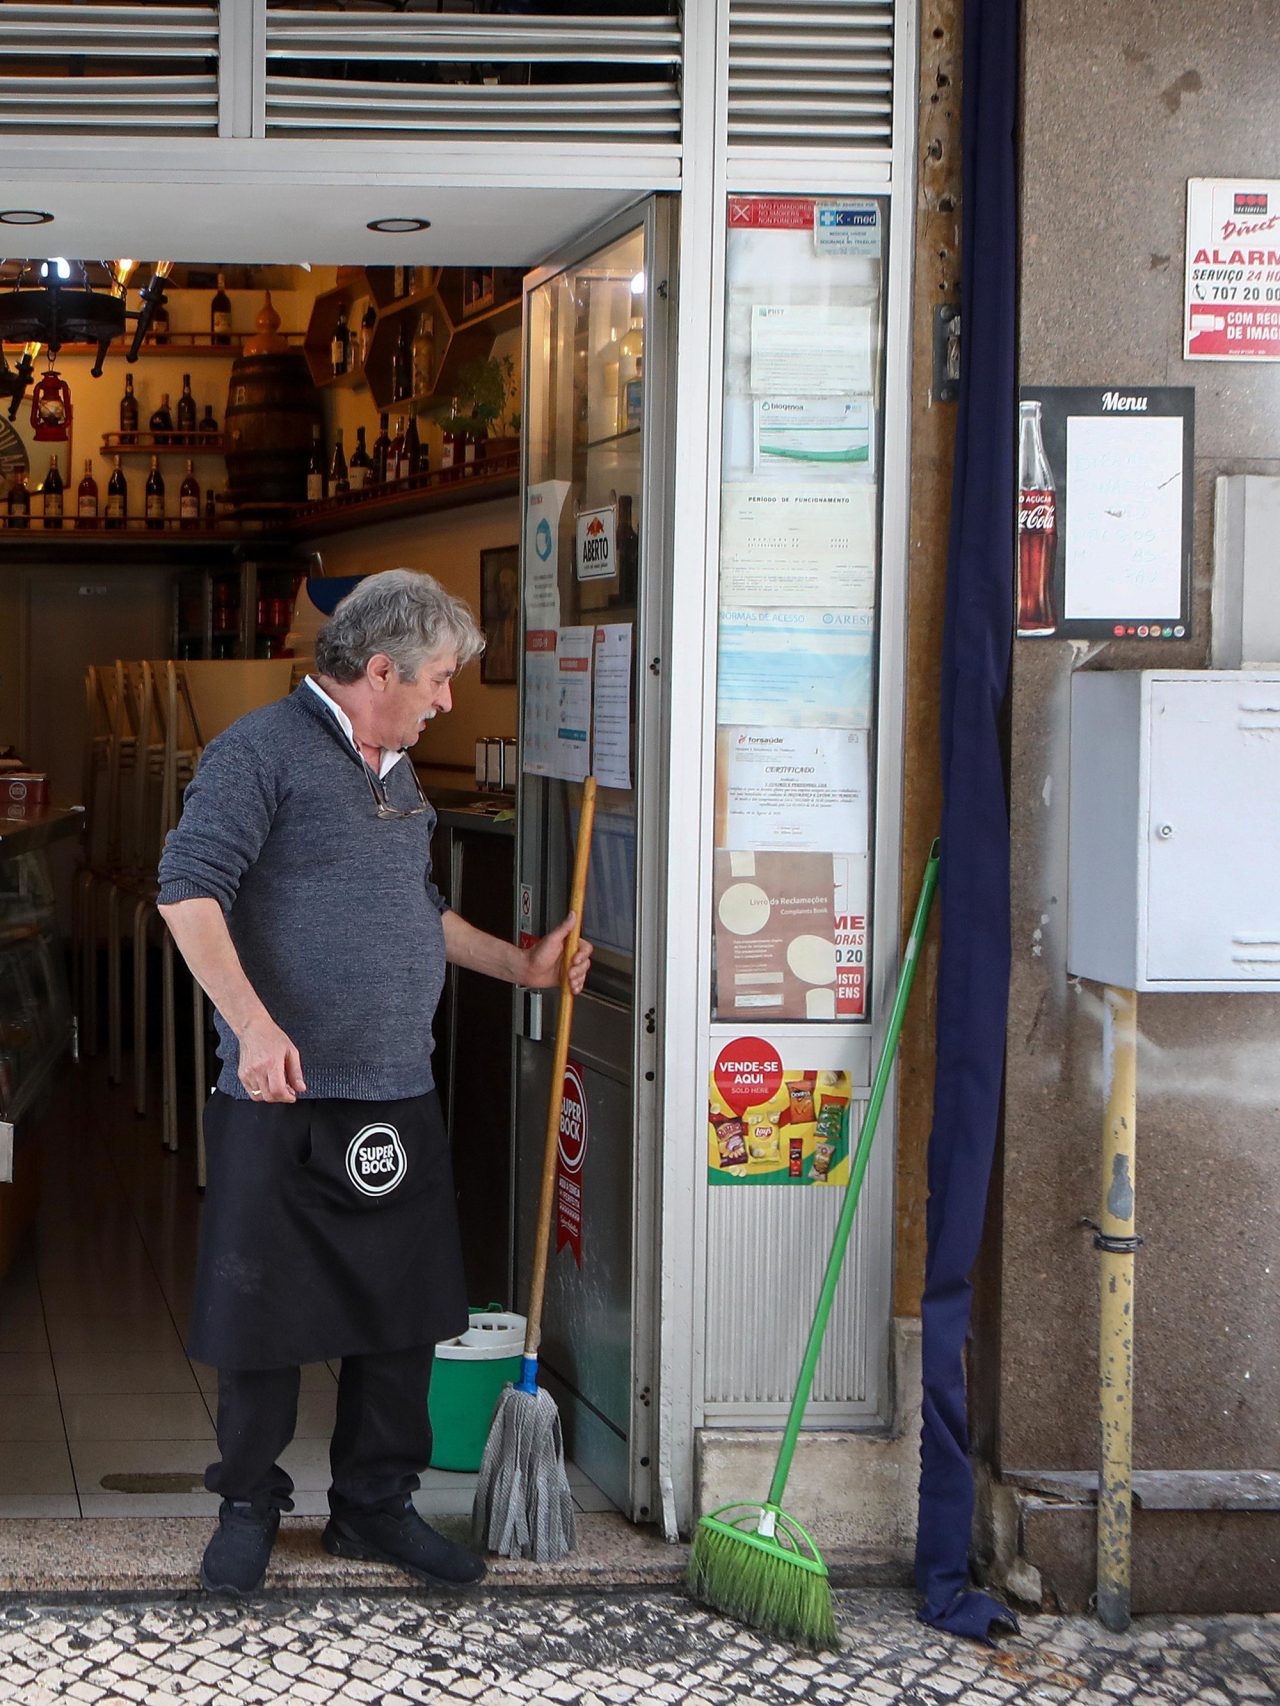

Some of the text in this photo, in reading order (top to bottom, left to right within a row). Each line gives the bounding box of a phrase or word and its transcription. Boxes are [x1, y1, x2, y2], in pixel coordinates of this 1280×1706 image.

[1192, 269, 1243, 284] SERVIÇO
[1246, 271, 1262, 282] 24
[1212, 287, 1237, 301] 707
[1243, 287, 1260, 301] 20
[1226, 312, 1253, 326] COM
[1226, 326, 1244, 340] DE
[1102, 391, 1148, 411] Menu
[583, 537, 609, 562] ABERTO
[765, 766, 815, 774] CERTIFICADO
[847, 950, 863, 963] 20
[720, 1062, 779, 1072] VENDE-SE
[734, 1074, 763, 1084] AQUI
[560, 1114, 580, 1142] BOCK
[359, 1144, 394, 1161] SUPER
[362, 1157, 396, 1174] BOCK
